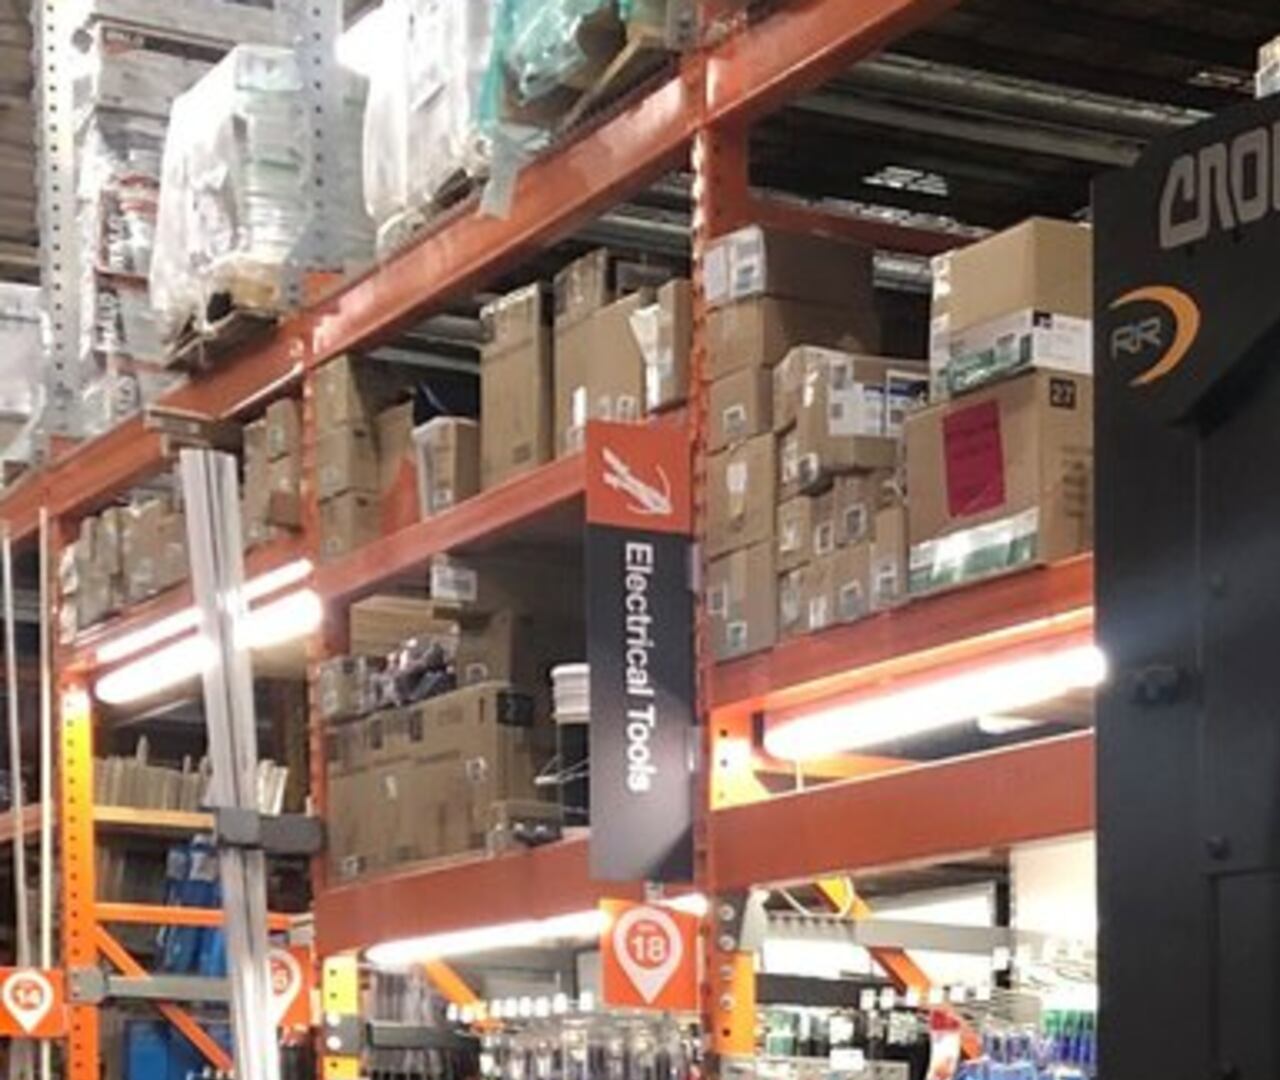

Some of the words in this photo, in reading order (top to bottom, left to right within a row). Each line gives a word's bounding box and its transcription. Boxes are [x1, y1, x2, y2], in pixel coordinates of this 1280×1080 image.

[626, 542, 655, 696] Electrical
[626, 704, 658, 792] Tools
[632, 934, 666, 963] 18
